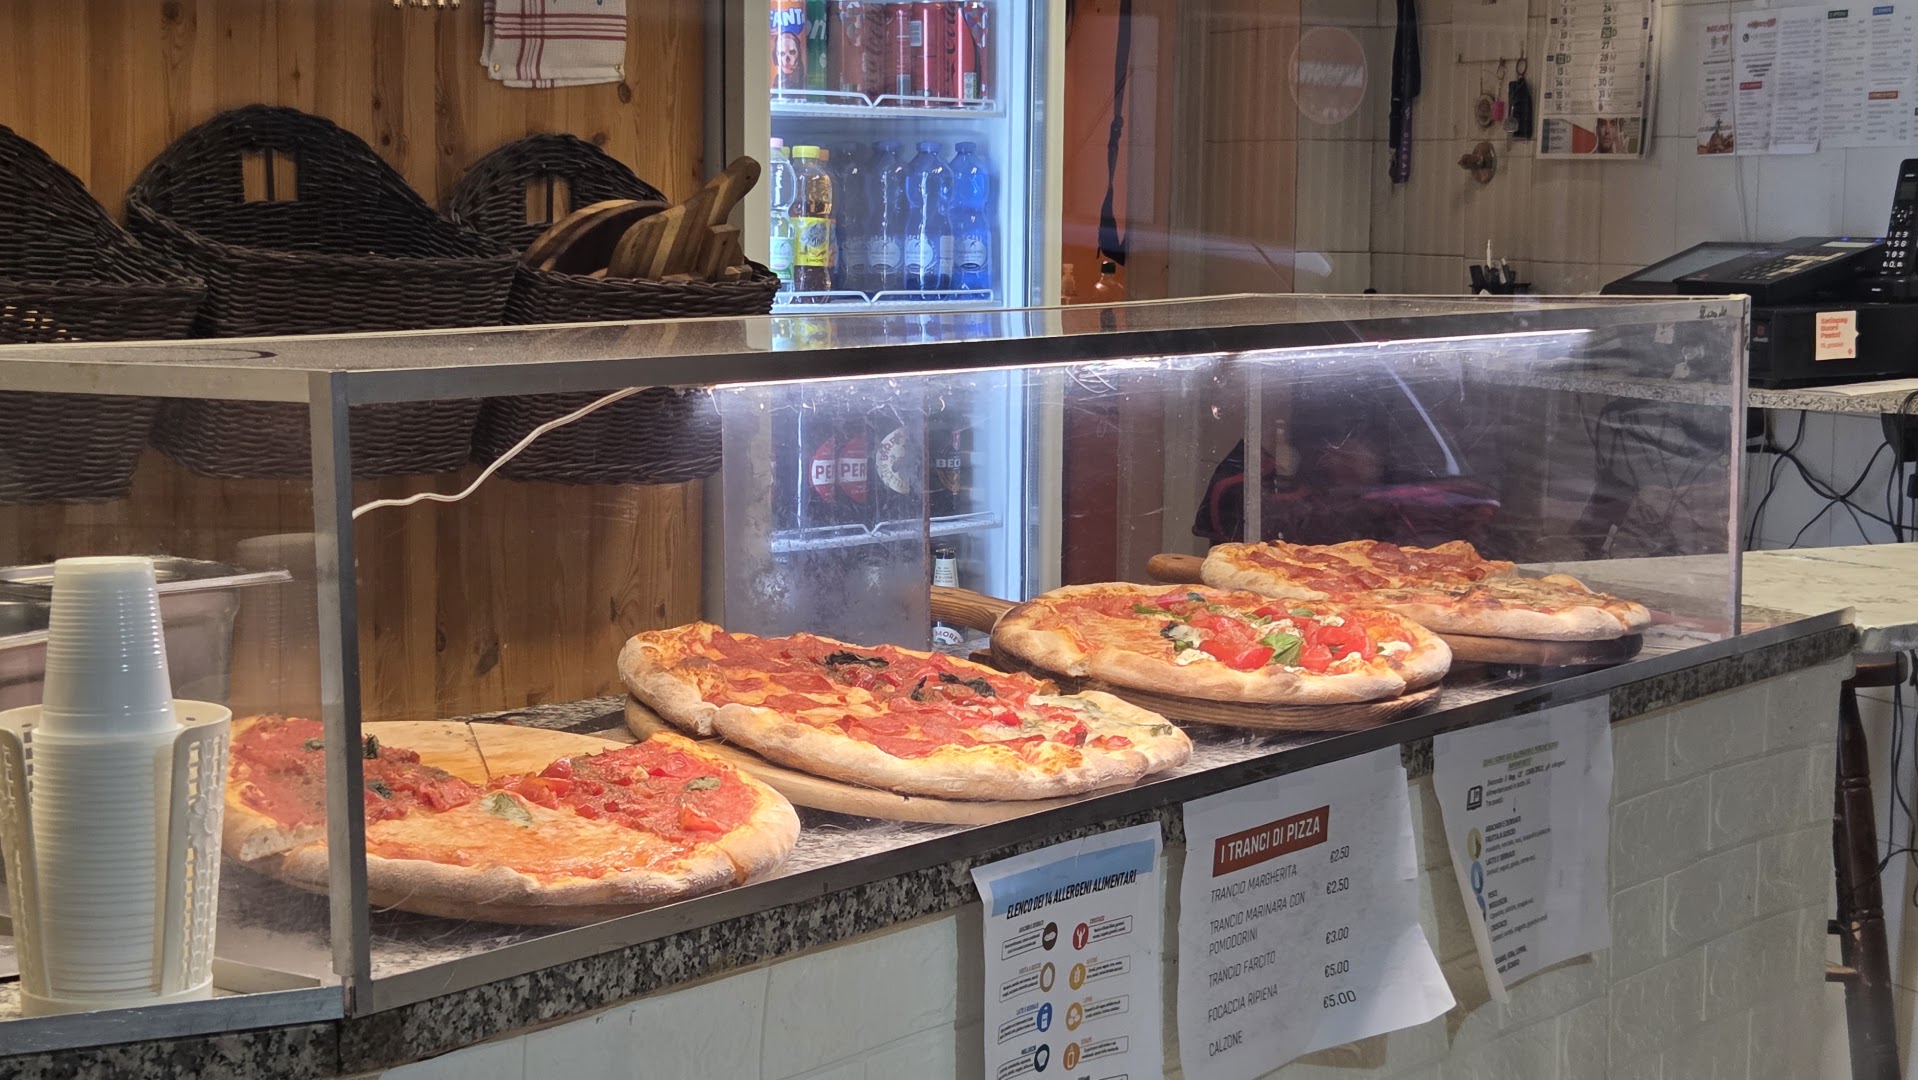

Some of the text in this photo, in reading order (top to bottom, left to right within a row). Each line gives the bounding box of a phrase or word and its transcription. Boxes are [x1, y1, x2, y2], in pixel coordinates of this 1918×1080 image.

[816, 465, 833, 479] PE
[1221, 816, 1320, 863] I TRANCI DI PIZZA
[1006, 869, 1137, 920] ELENCO DEI 14 ALLERGENI ALIMENTARI
[1210, 882, 1246, 903] TRANCIO
[1248, 864, 1297, 893] MARGHERITA
[1210, 880, 1349, 935] TRANCIO MARINARA CON €2.50
[1208, 927, 1349, 988] TRANCIO FARCITO €3.00
[1209, 928, 1258, 956] POMODORINI
[1208, 960, 1349, 1023] FOCACCIA RIPIENA €5.00
[1209, 990, 1356, 1057] CALZONE €5.00
